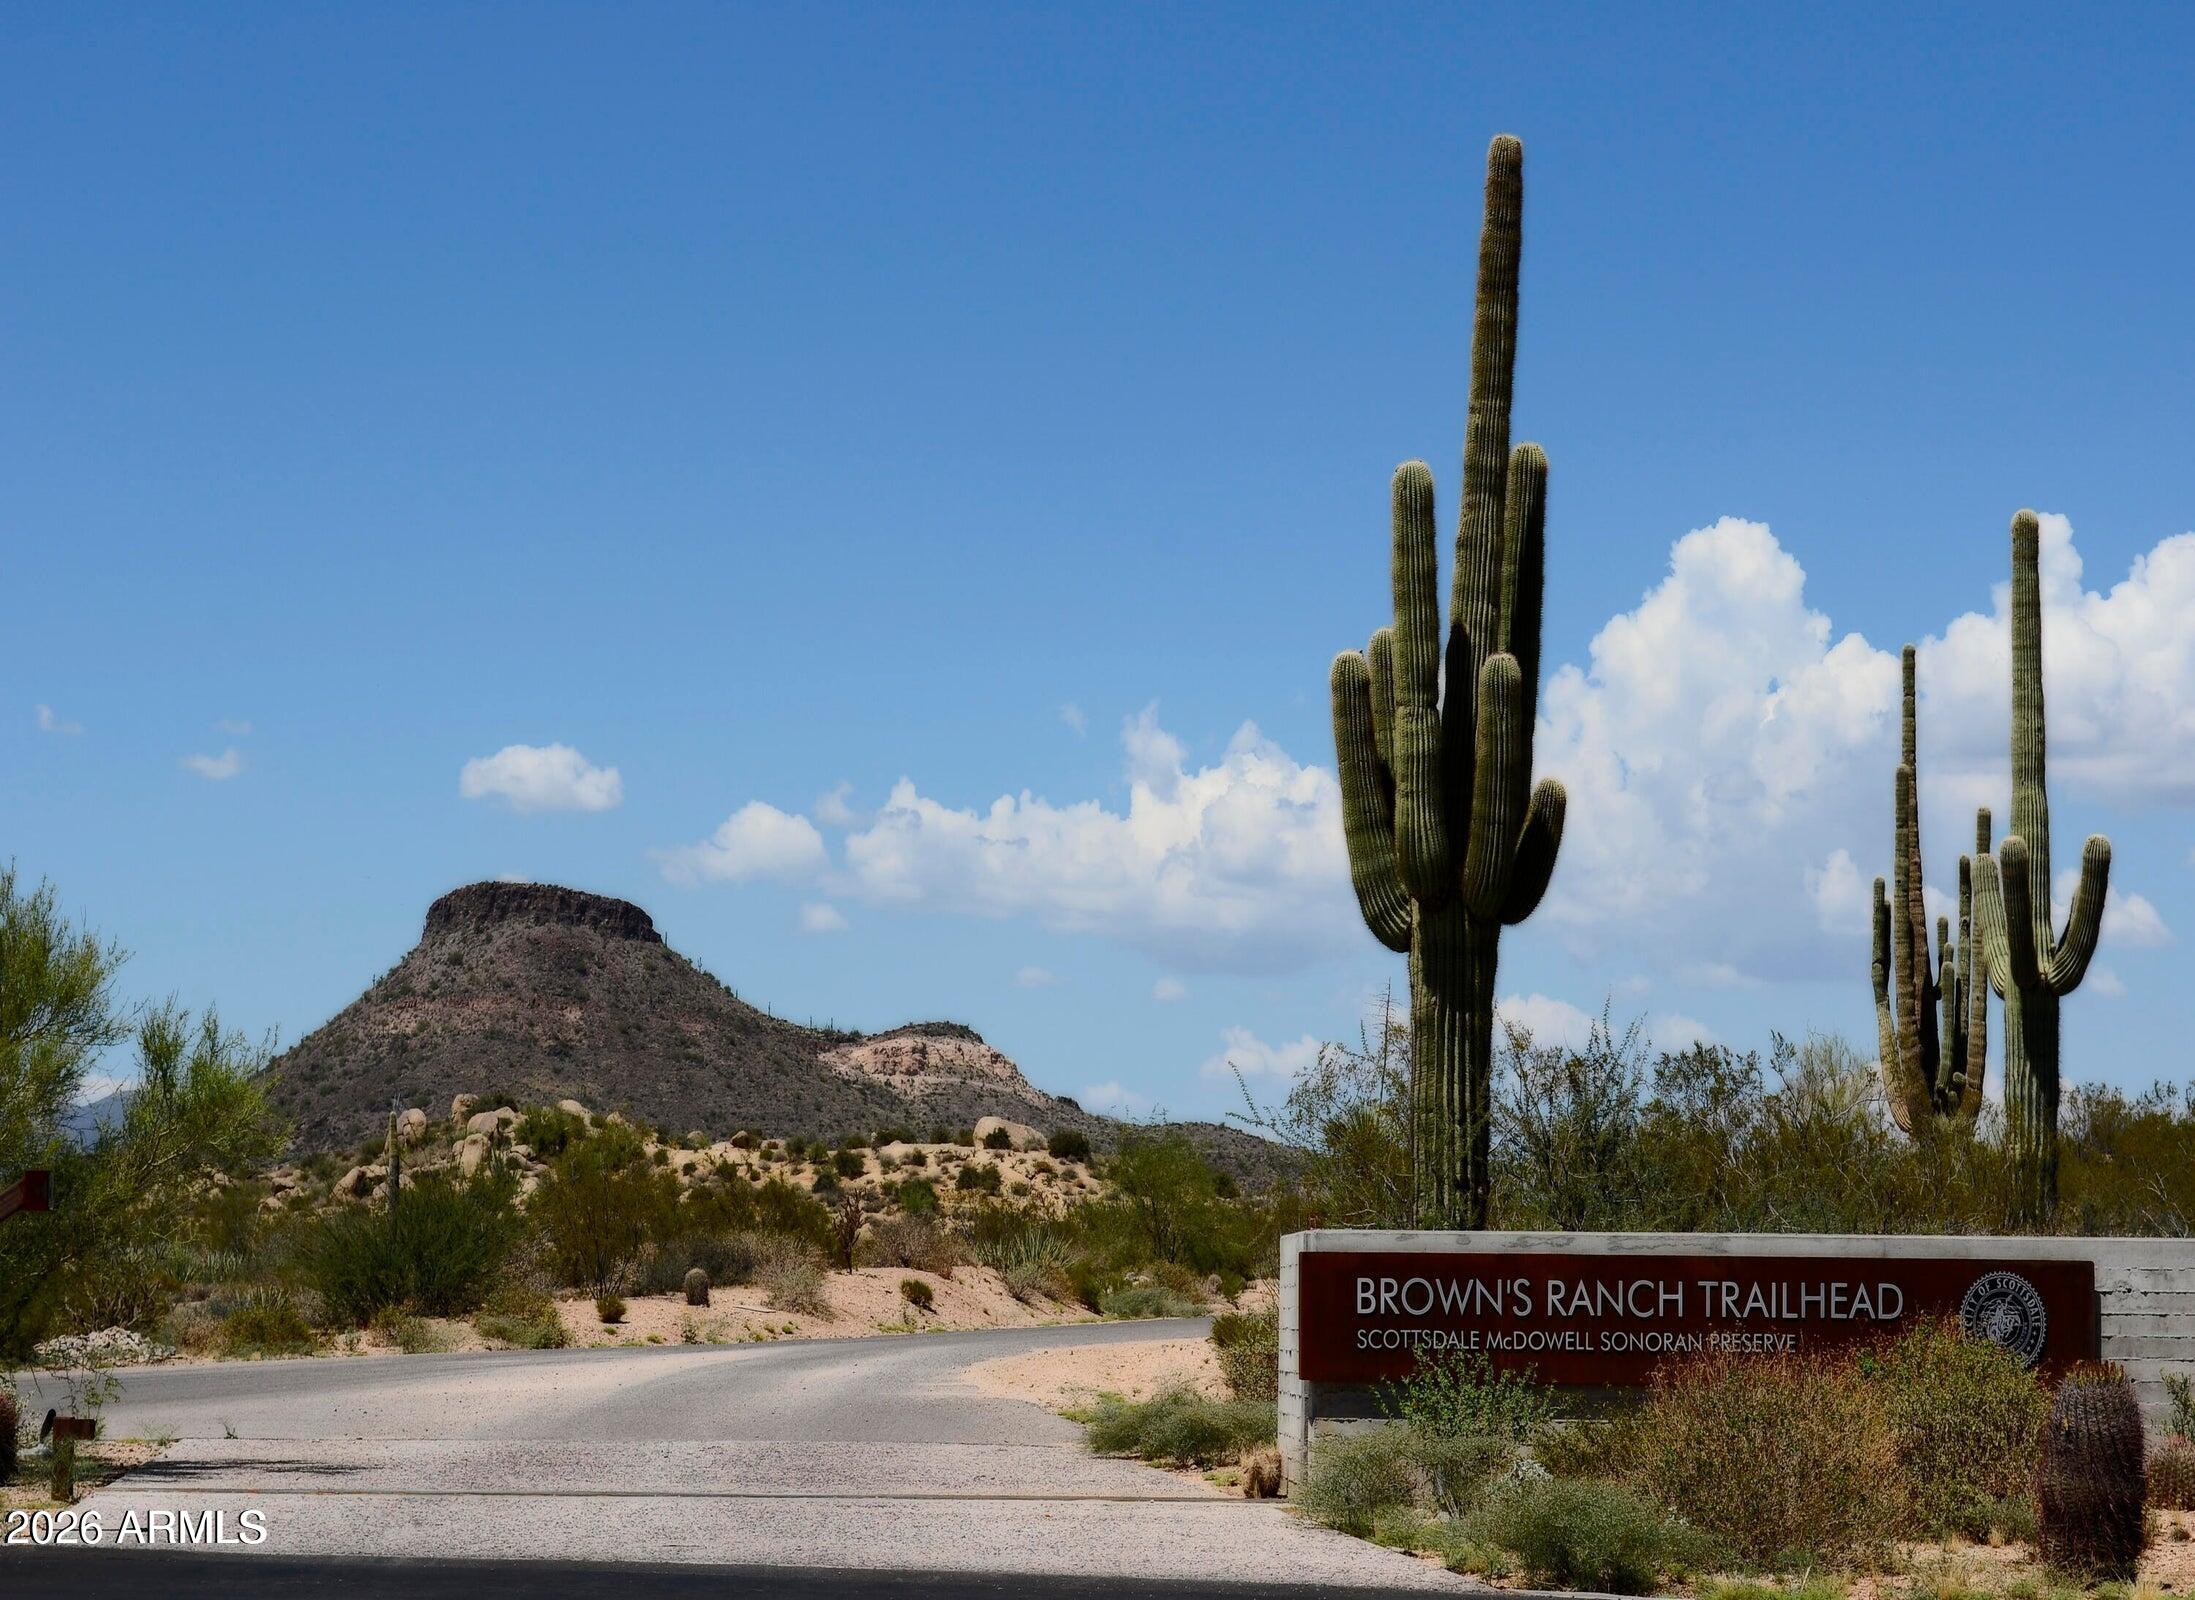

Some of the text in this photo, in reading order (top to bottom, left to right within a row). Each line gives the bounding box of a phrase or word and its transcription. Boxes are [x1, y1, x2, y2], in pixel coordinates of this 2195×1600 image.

[1356, 1277, 1904, 1320] BROWN'S RANCH TRAILHEAD
[1964, 1278, 2041, 1327] CITY OF SCOTTSDALE
[1356, 1329, 1796, 1353] SCOTTSDALE McDOWELL SONORAN PRESERVE
